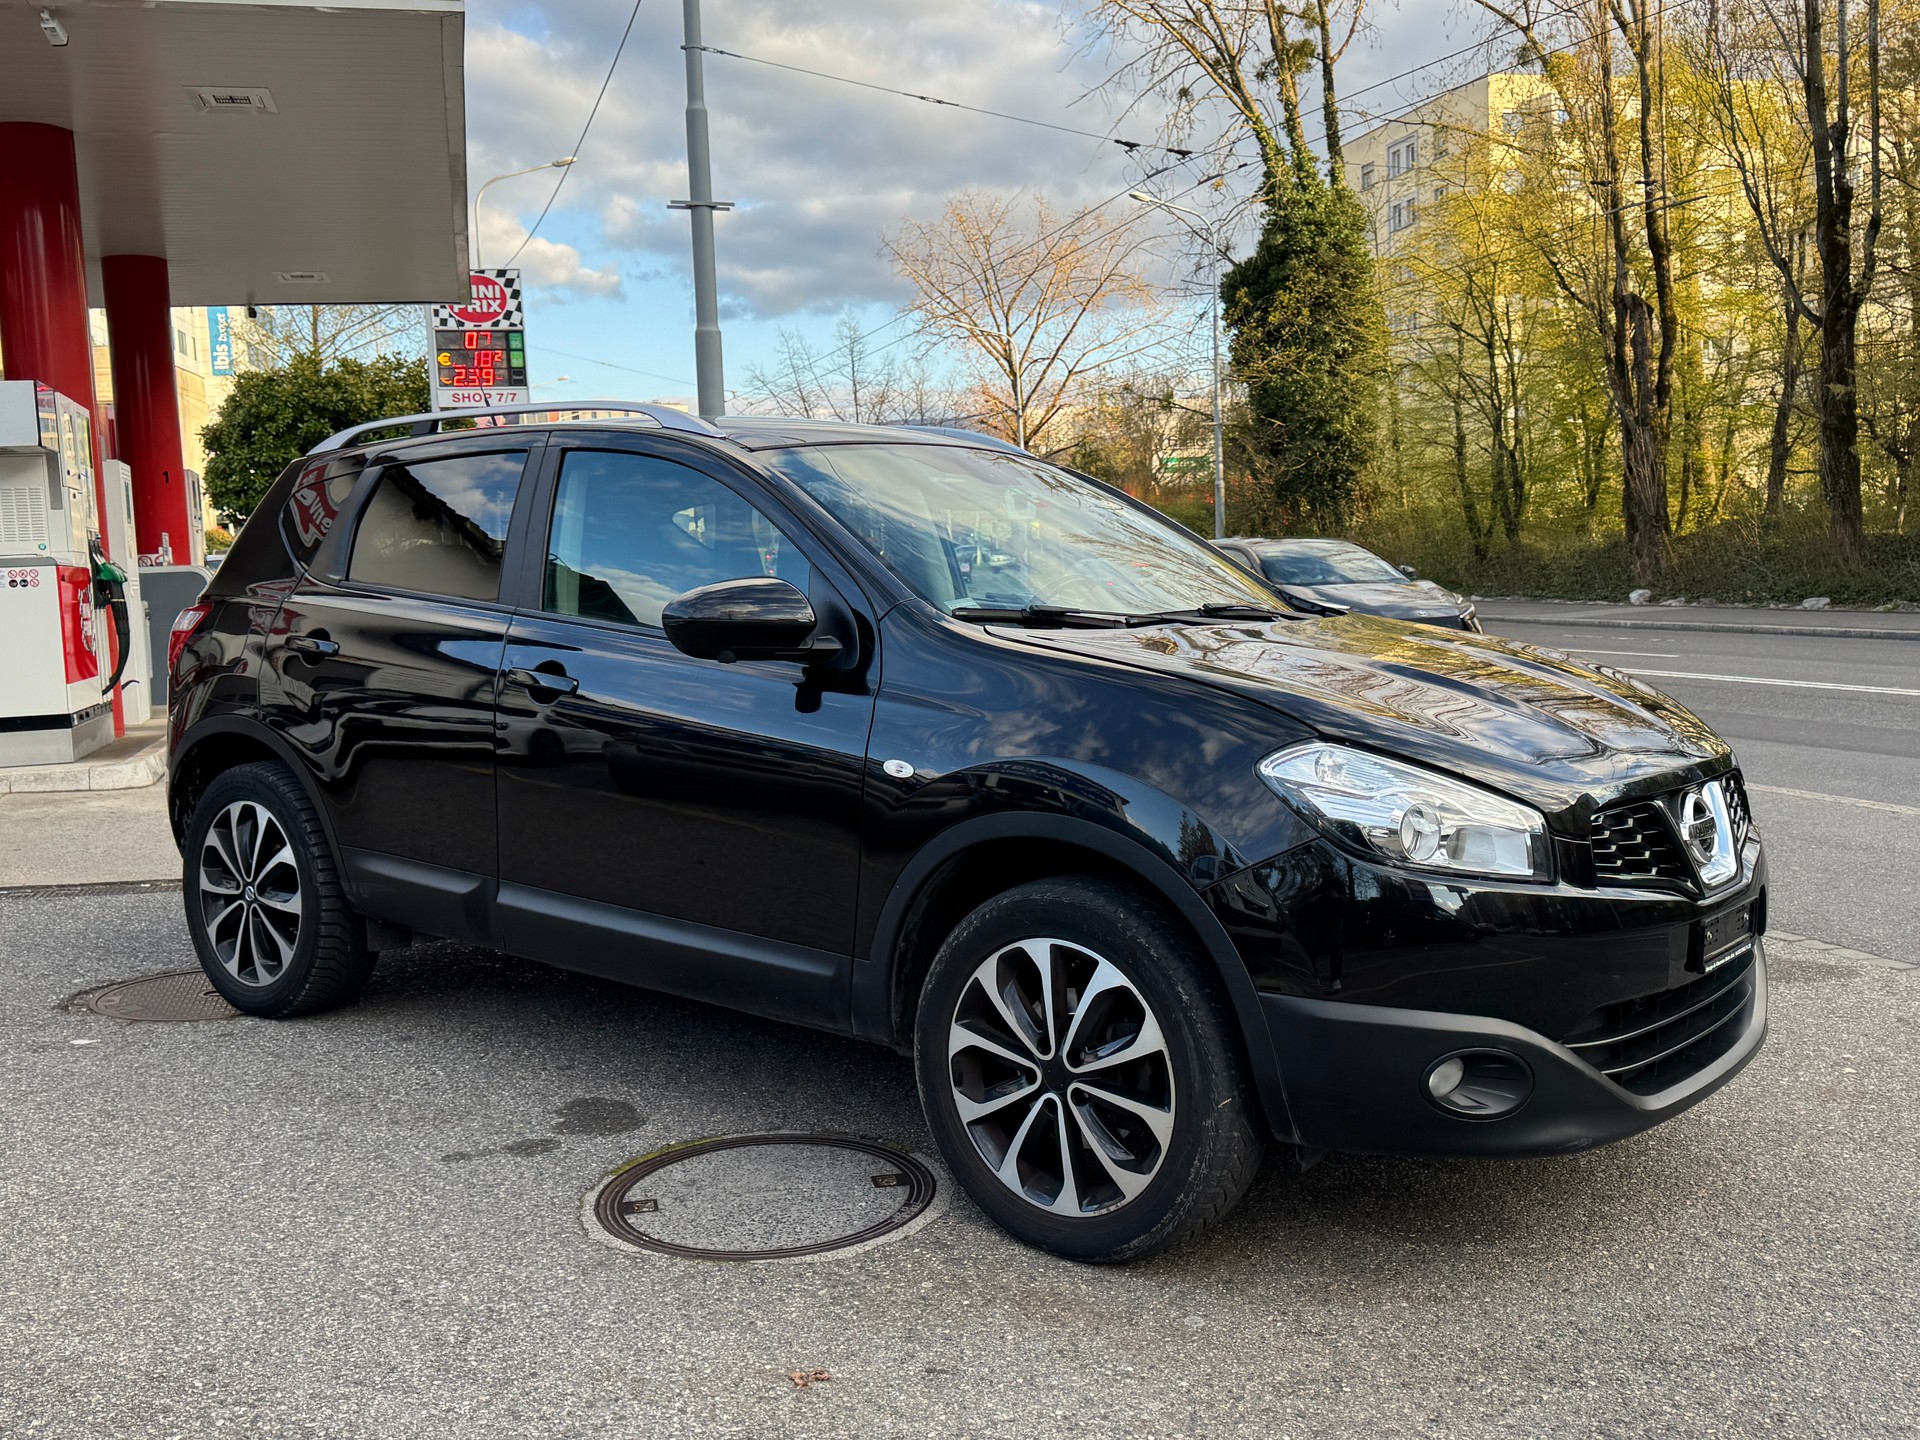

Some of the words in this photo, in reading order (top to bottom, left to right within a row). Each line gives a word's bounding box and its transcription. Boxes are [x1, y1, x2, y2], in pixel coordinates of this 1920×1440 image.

[471, 285, 501, 299] INI
[213, 344, 230, 370] ibis
[452, 393, 492, 403] SHOP
[496, 393, 517, 403] 7/7
[162, 471, 170, 485] 1
